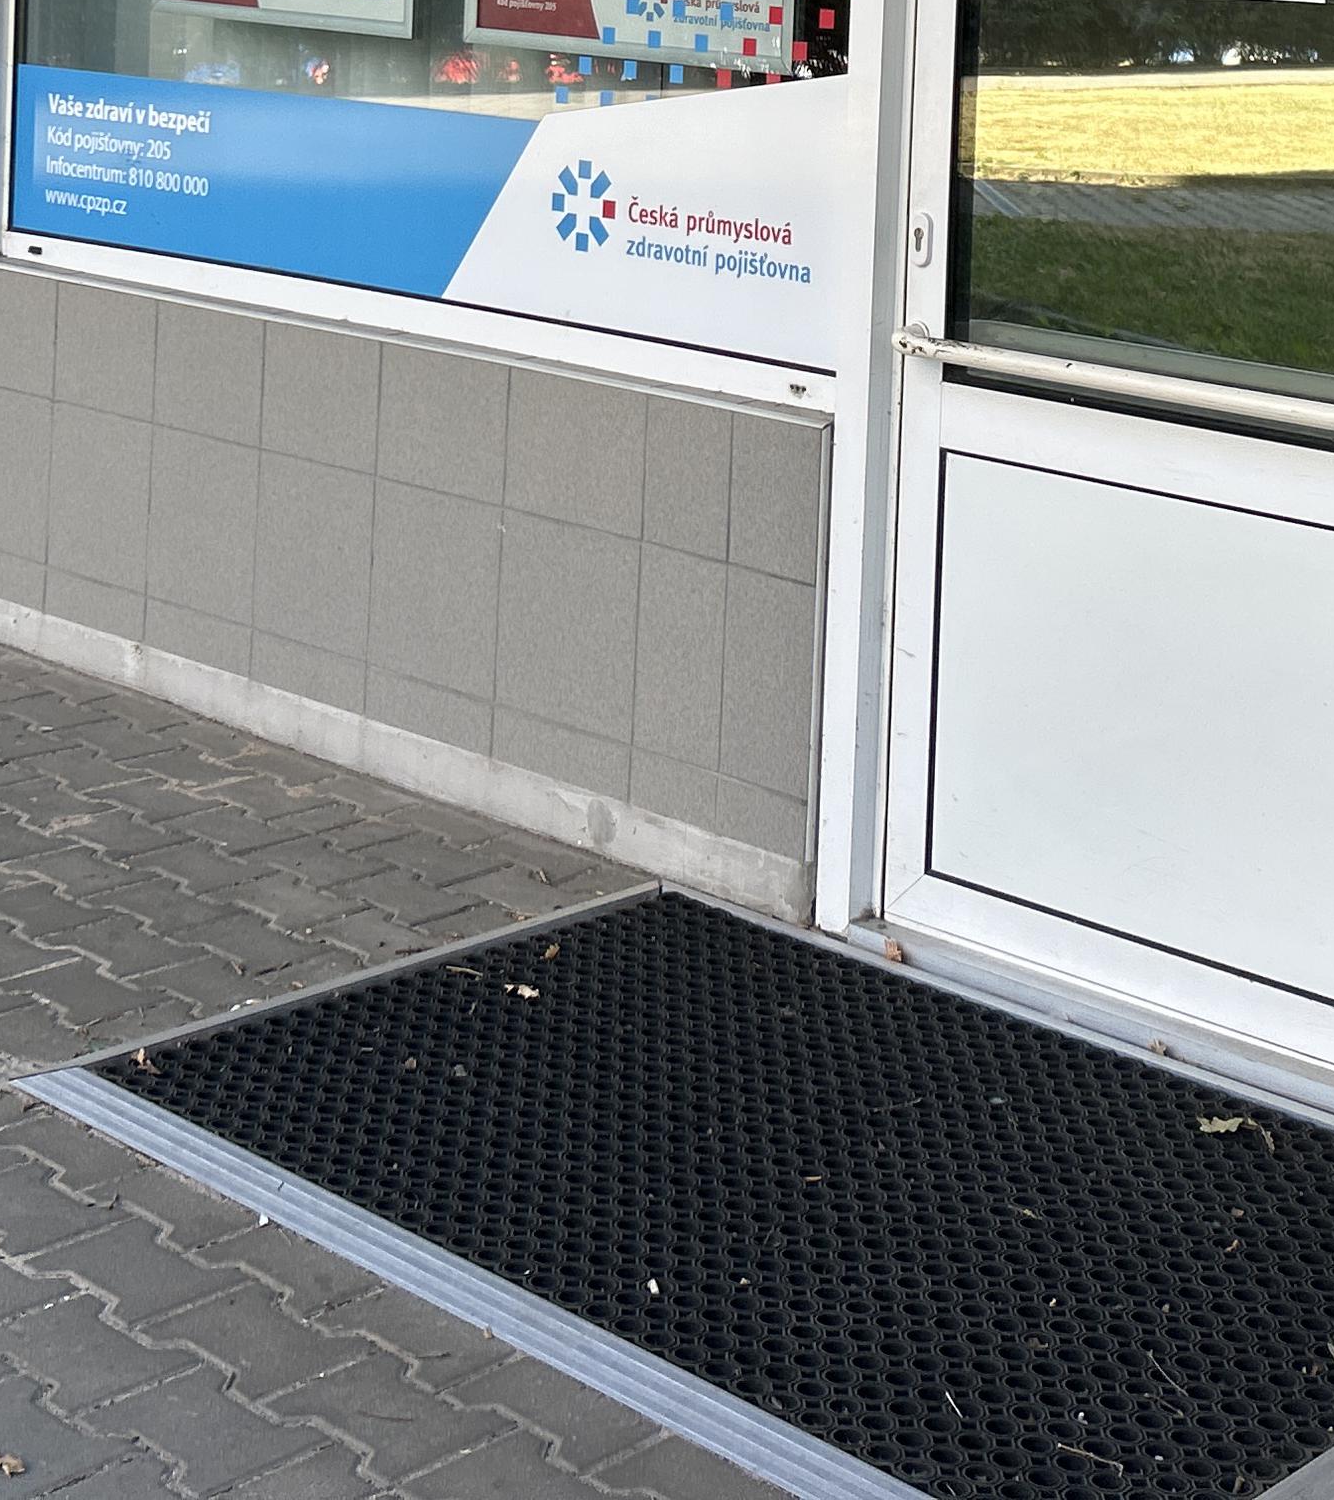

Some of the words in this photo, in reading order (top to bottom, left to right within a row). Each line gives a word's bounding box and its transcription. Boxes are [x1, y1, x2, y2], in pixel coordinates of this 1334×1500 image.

[48, 93, 83, 118] Vaše
[84, 97, 134, 124] zdraví
[135, 108, 146, 121] v
[148, 103, 212, 136] bezpečí
[47, 125, 73, 146] Kód
[73, 132, 145, 160] pojišťovny:
[146, 139, 172, 160] 205
[46, 155, 128, 184] Infocentrum:
[128, 167, 154, 188] 810
[156, 171, 182, 192] 800
[183, 175, 210, 197] 000
[45, 188, 128, 217] www.cpzp.cz
[628, 195, 679, 229] Česká
[686, 210, 792, 246] průmyslová
[626, 235, 709, 268] zdravotní
[715, 250, 812, 284] pojišťovna
